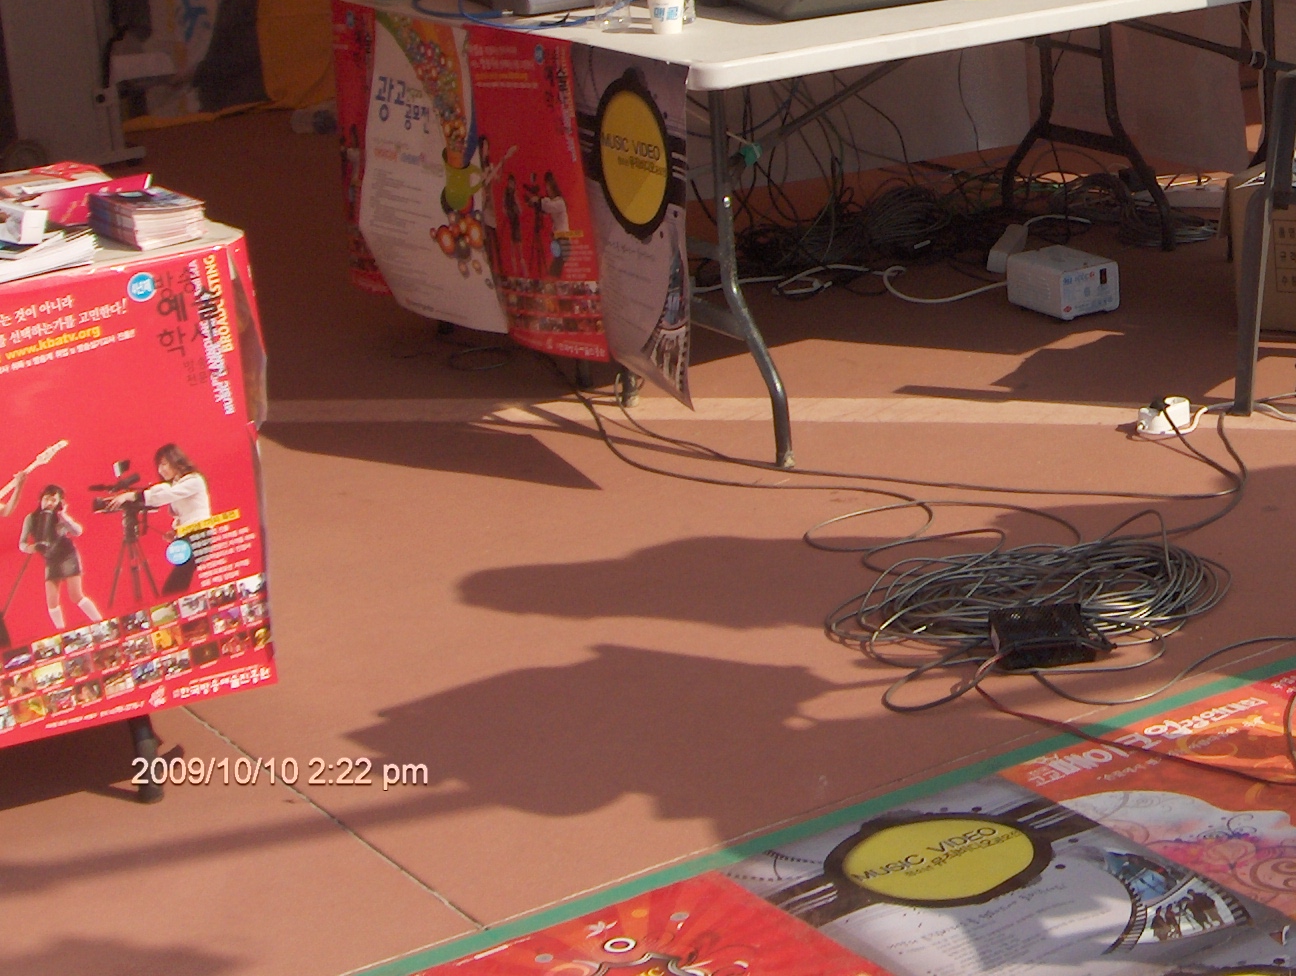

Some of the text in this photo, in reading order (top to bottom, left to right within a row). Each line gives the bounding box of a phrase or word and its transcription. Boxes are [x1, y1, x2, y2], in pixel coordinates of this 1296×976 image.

[375, 75, 406, 122] 광고
[600, 132, 661, 162] MUSIC VIDEO
[14, 304, 37, 323] 것이
[38, 294, 75, 315] 아니라
[78, 297, 128, 324] 고민한다!
[5, 325, 102, 360] www.kbatv.org
[850, 853, 926, 883] MUSIC
[926, 825, 998, 855] VIDEO
